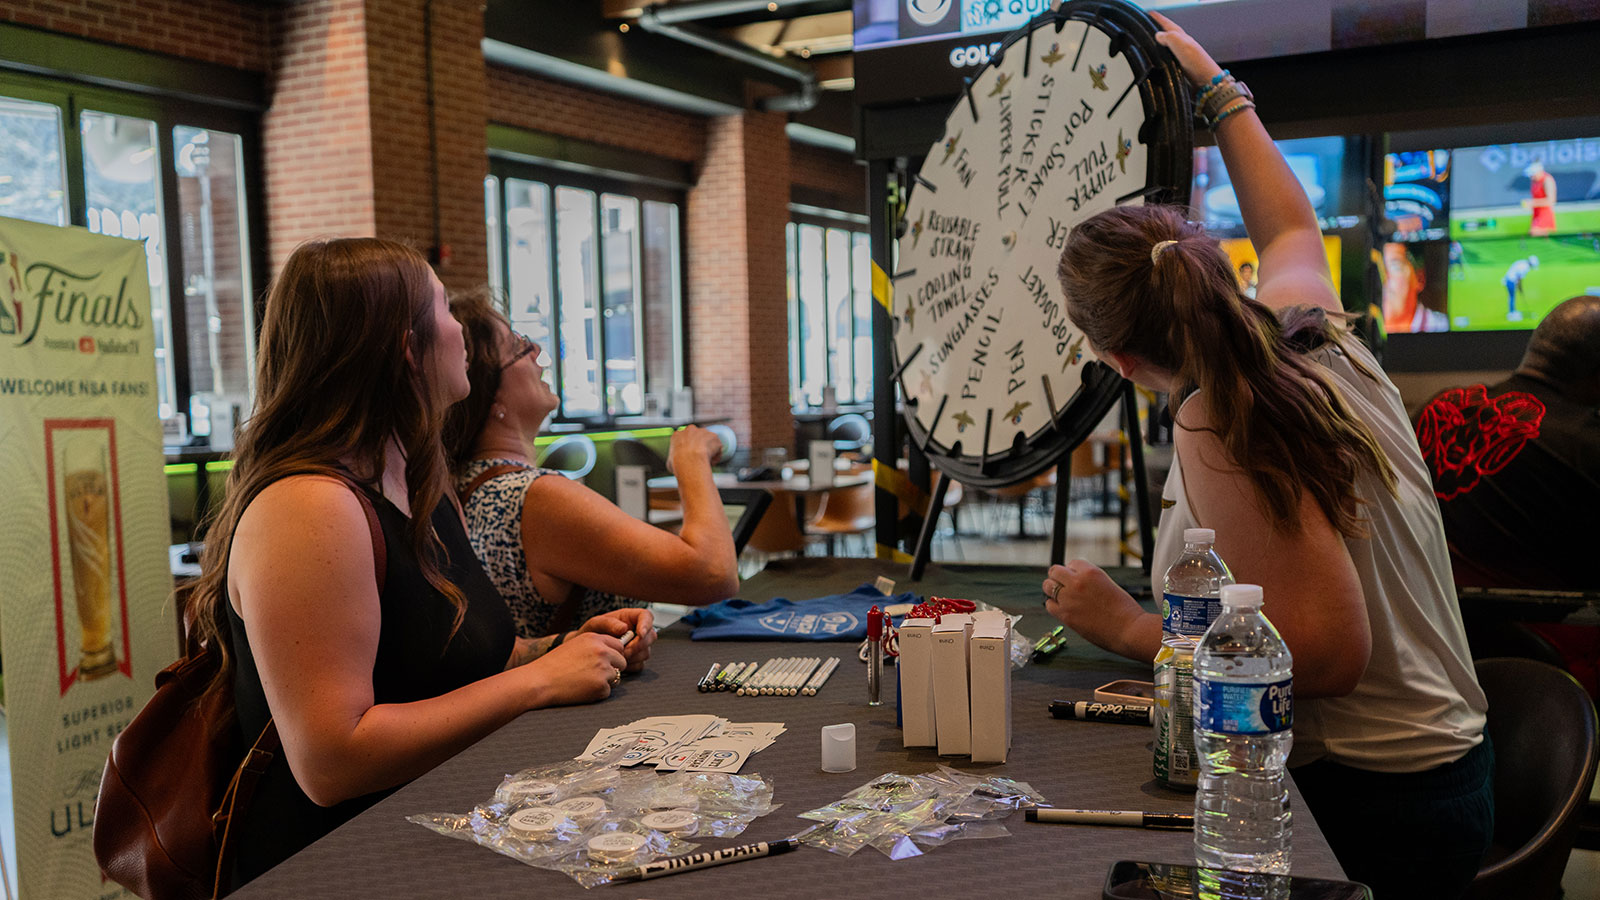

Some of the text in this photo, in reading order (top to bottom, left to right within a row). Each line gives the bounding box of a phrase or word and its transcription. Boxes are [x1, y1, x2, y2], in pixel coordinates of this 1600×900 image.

[1009, 0, 1051, 14] QUI
[1011, 74, 1054, 185] STICKER
[952, 148, 978, 189] FAN
[1018, 98, 1094, 228] POP SOCKET
[1068, 140, 1109, 182] PULL
[1511, 138, 1600, 169] balois
[1066, 160, 1117, 211] ZIPPER
[926, 209, 981, 242] REUSABLE
[1046, 216, 1075, 250] ER
[930, 235, 976, 262] STRAW
[16, 262, 143, 347] Finals
[917, 264, 972, 306] COOLING
[926, 285, 972, 323] TOWEL
[929, 266, 1000, 375] SUNGLASSES
[1018, 264, 1072, 356] POP SOCKET
[961, 307, 1004, 399] PENCIL
[1005, 339, 1027, 395] PEN
[0, 379, 75, 397] WELCOME
[79, 379, 109, 396] NBA
[62, 696, 134, 729] SUPERIOR
[1088, 703, 1124, 717] EXPO
[57, 719, 132, 754] LIGHT BE
[51, 796, 99, 838] UL
[668, 843, 762, 870] INDYCAR
